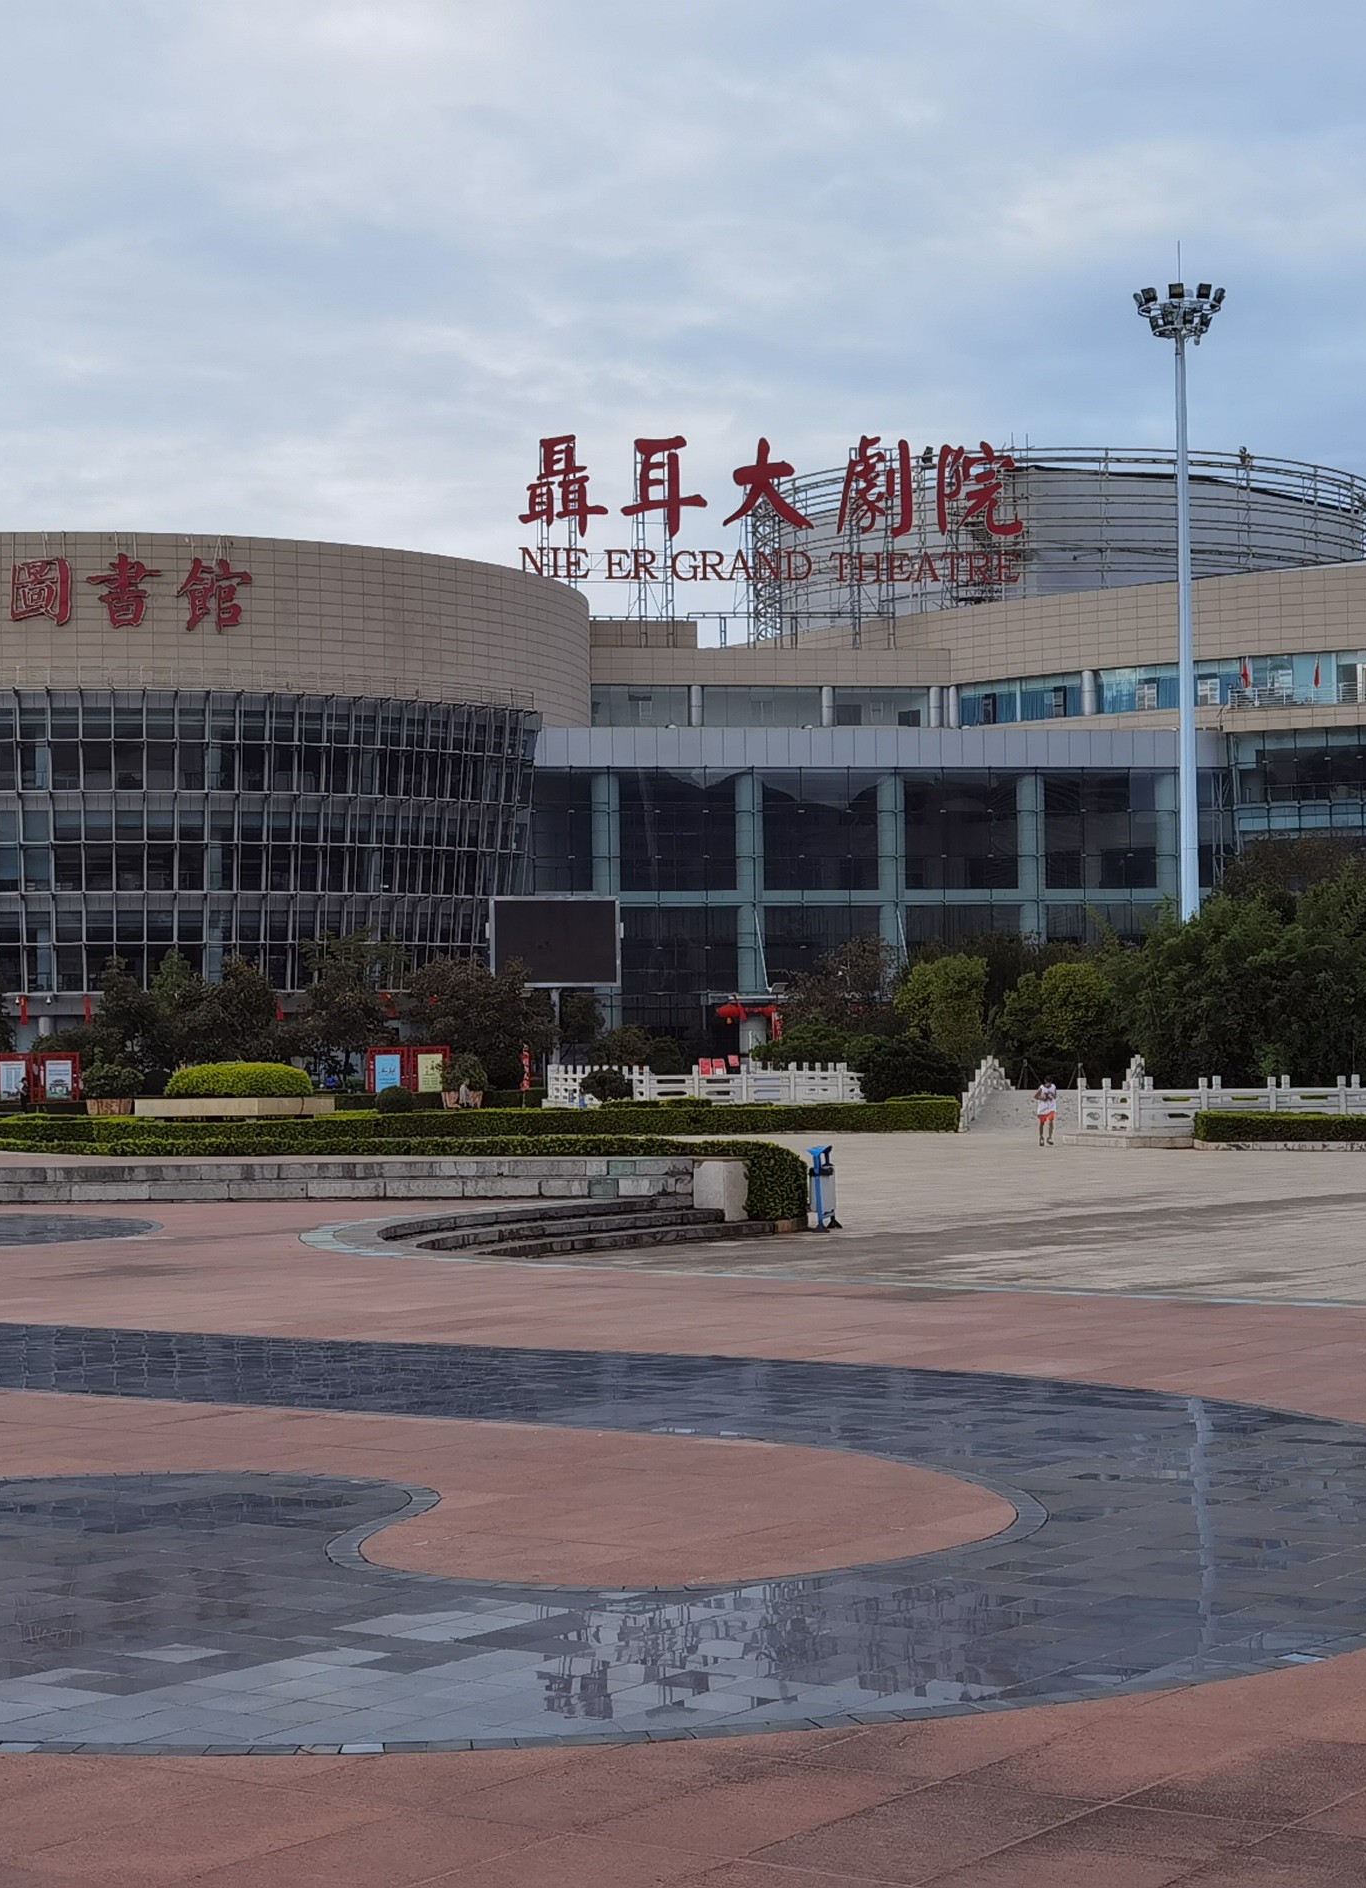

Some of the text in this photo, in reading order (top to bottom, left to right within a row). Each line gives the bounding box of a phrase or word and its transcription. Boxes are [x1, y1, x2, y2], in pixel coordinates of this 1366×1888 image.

[519, 547, 1021, 583] NIE ER GRAND THEATRE
